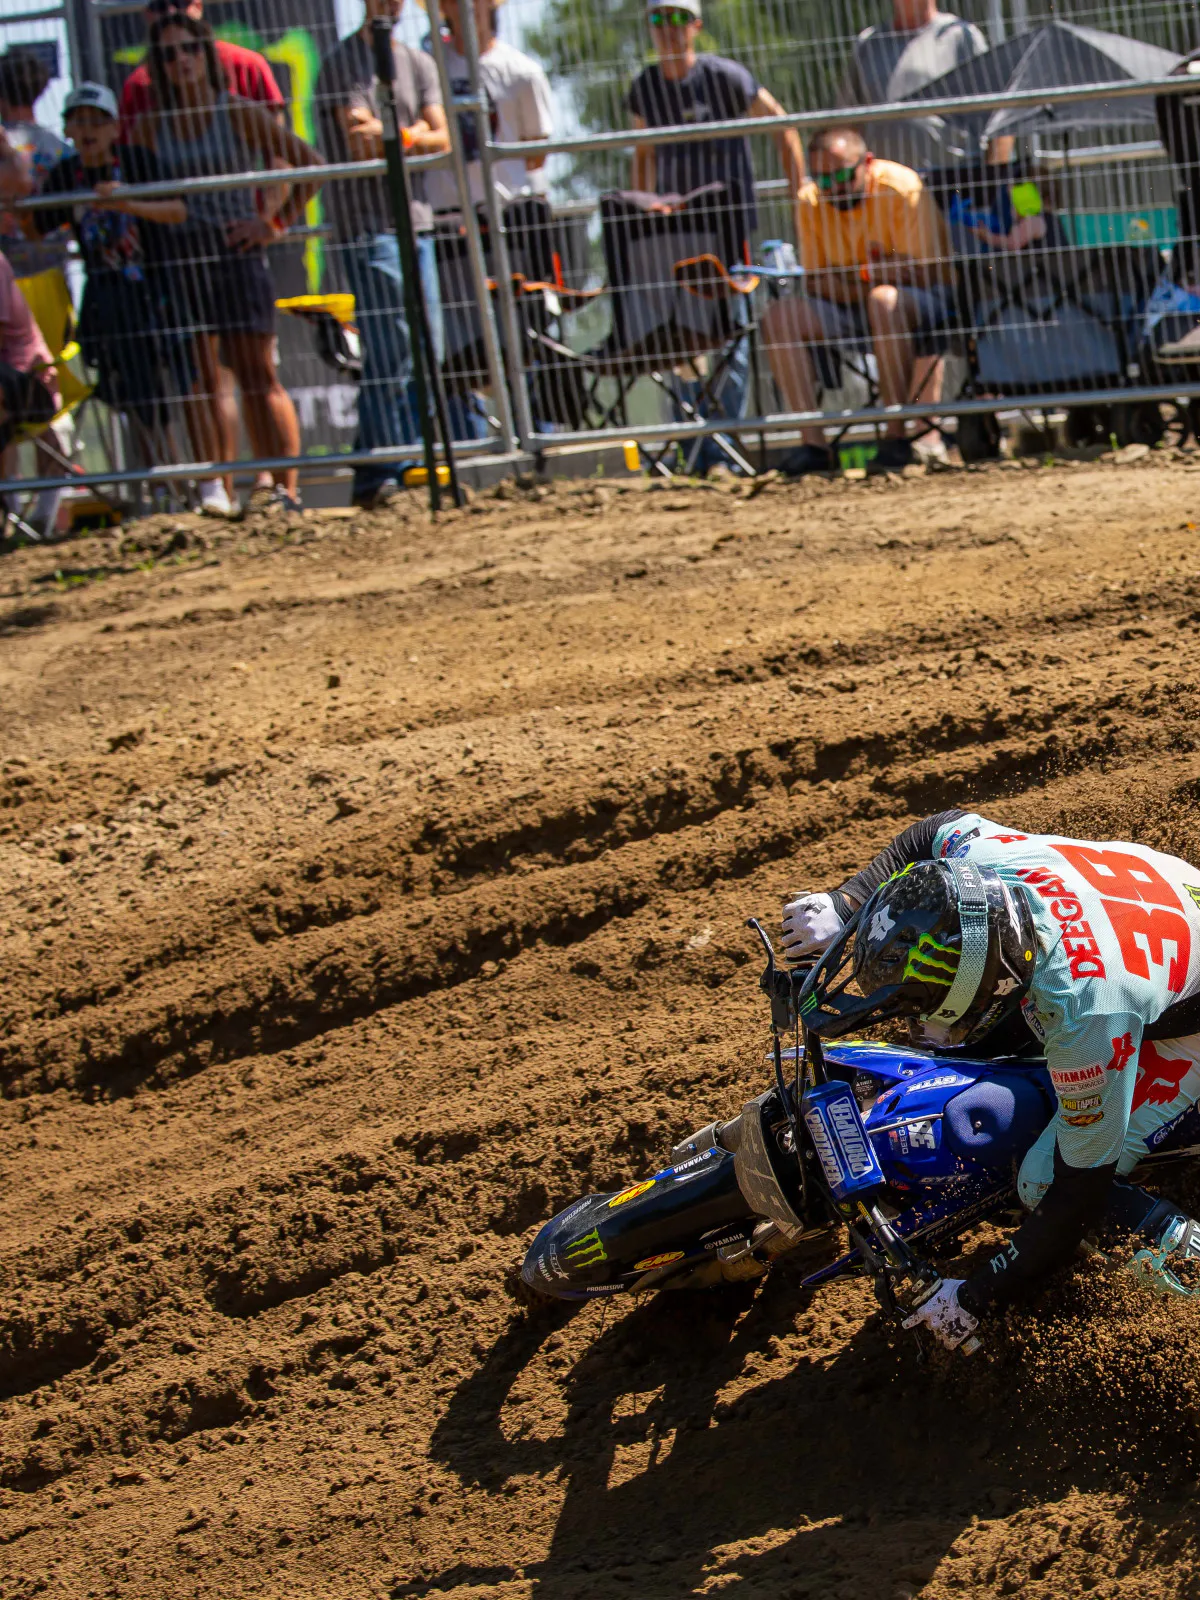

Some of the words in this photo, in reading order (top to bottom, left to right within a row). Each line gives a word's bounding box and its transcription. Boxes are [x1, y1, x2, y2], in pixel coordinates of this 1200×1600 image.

[1015, 866, 1107, 982] DEEGAN
[1046, 844, 1191, 993] 38
[1059, 1065, 1103, 1083] YAMAHA
[808, 1113, 842, 1186] PROTAPER
[831, 1098, 869, 1173] PROTAPER
[673, 1155, 703, 1174] YAMAHA
[713, 1233, 745, 1248] YAMAHA
[538, 1254, 553, 1281] YAMAHA
